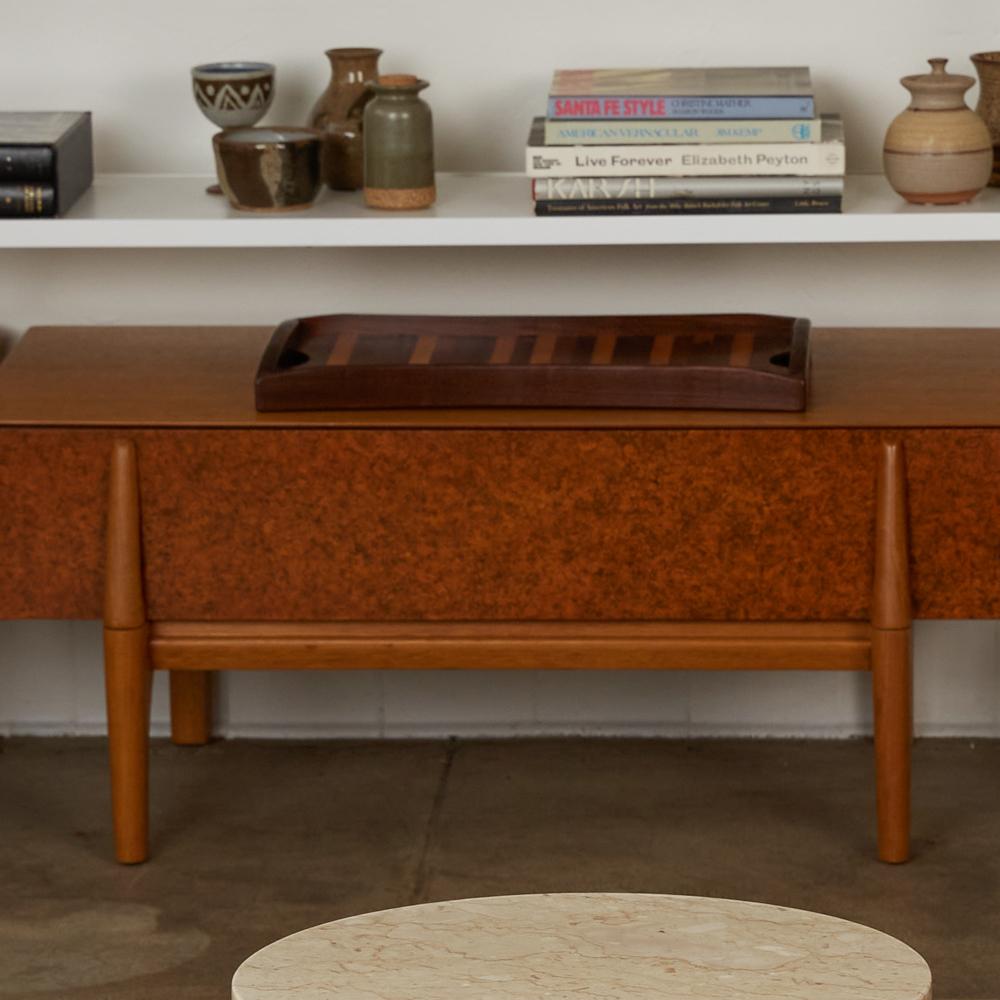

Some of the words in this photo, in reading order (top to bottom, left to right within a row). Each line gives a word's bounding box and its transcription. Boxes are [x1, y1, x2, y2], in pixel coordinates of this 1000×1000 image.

[555, 98, 600, 116] SANTA
[603, 98, 620, 115] FE
[624, 97, 666, 116] STYLE
[559, 127, 617, 139] AMERICAN
[618, 127, 699, 138] VERNACULAR
[575, 155, 607, 167] Live
[610, 155, 672, 167] Forever
[681, 154, 753, 167] Elizabeth
[756, 153, 808, 168] Peyton
[547, 177, 656, 199] KARSH
